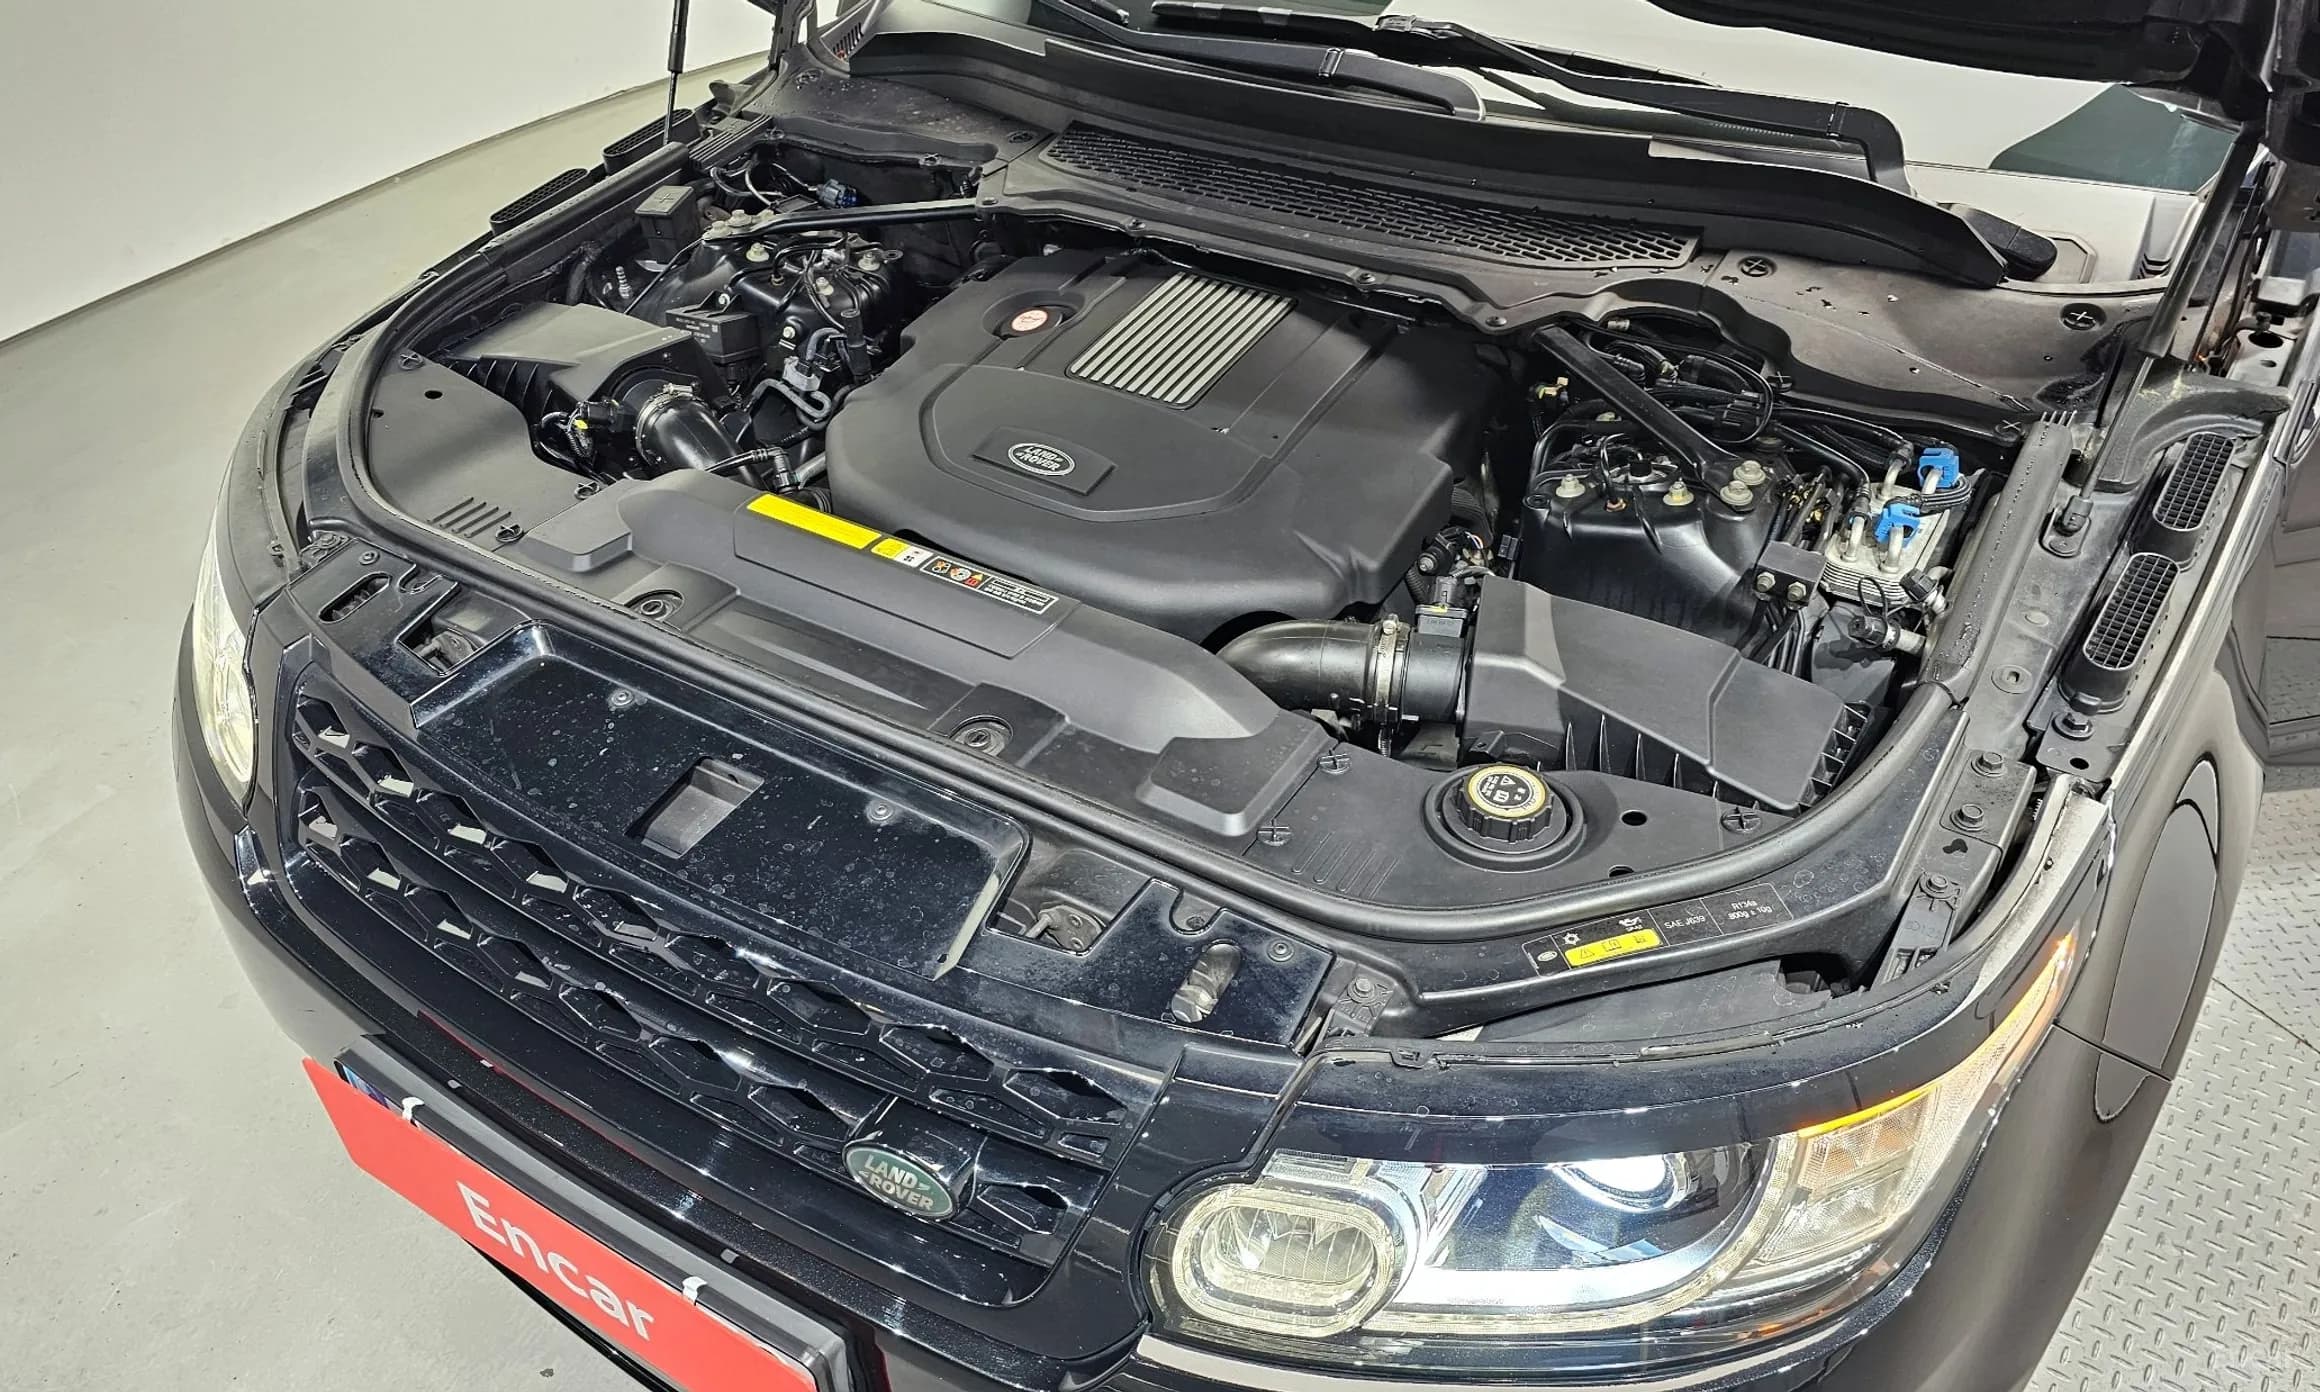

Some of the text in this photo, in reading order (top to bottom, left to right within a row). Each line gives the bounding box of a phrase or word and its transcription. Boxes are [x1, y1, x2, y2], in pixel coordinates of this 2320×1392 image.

[1020, 453, 1061, 471] ROVER
[1024, 446, 1058, 461] LAND
[1664, 919, 1685, 929] SAE
[864, 1153, 918, 1189] LAND
[869, 1173, 935, 1211] ROVER
[456, 1180, 657, 1342] Encar
